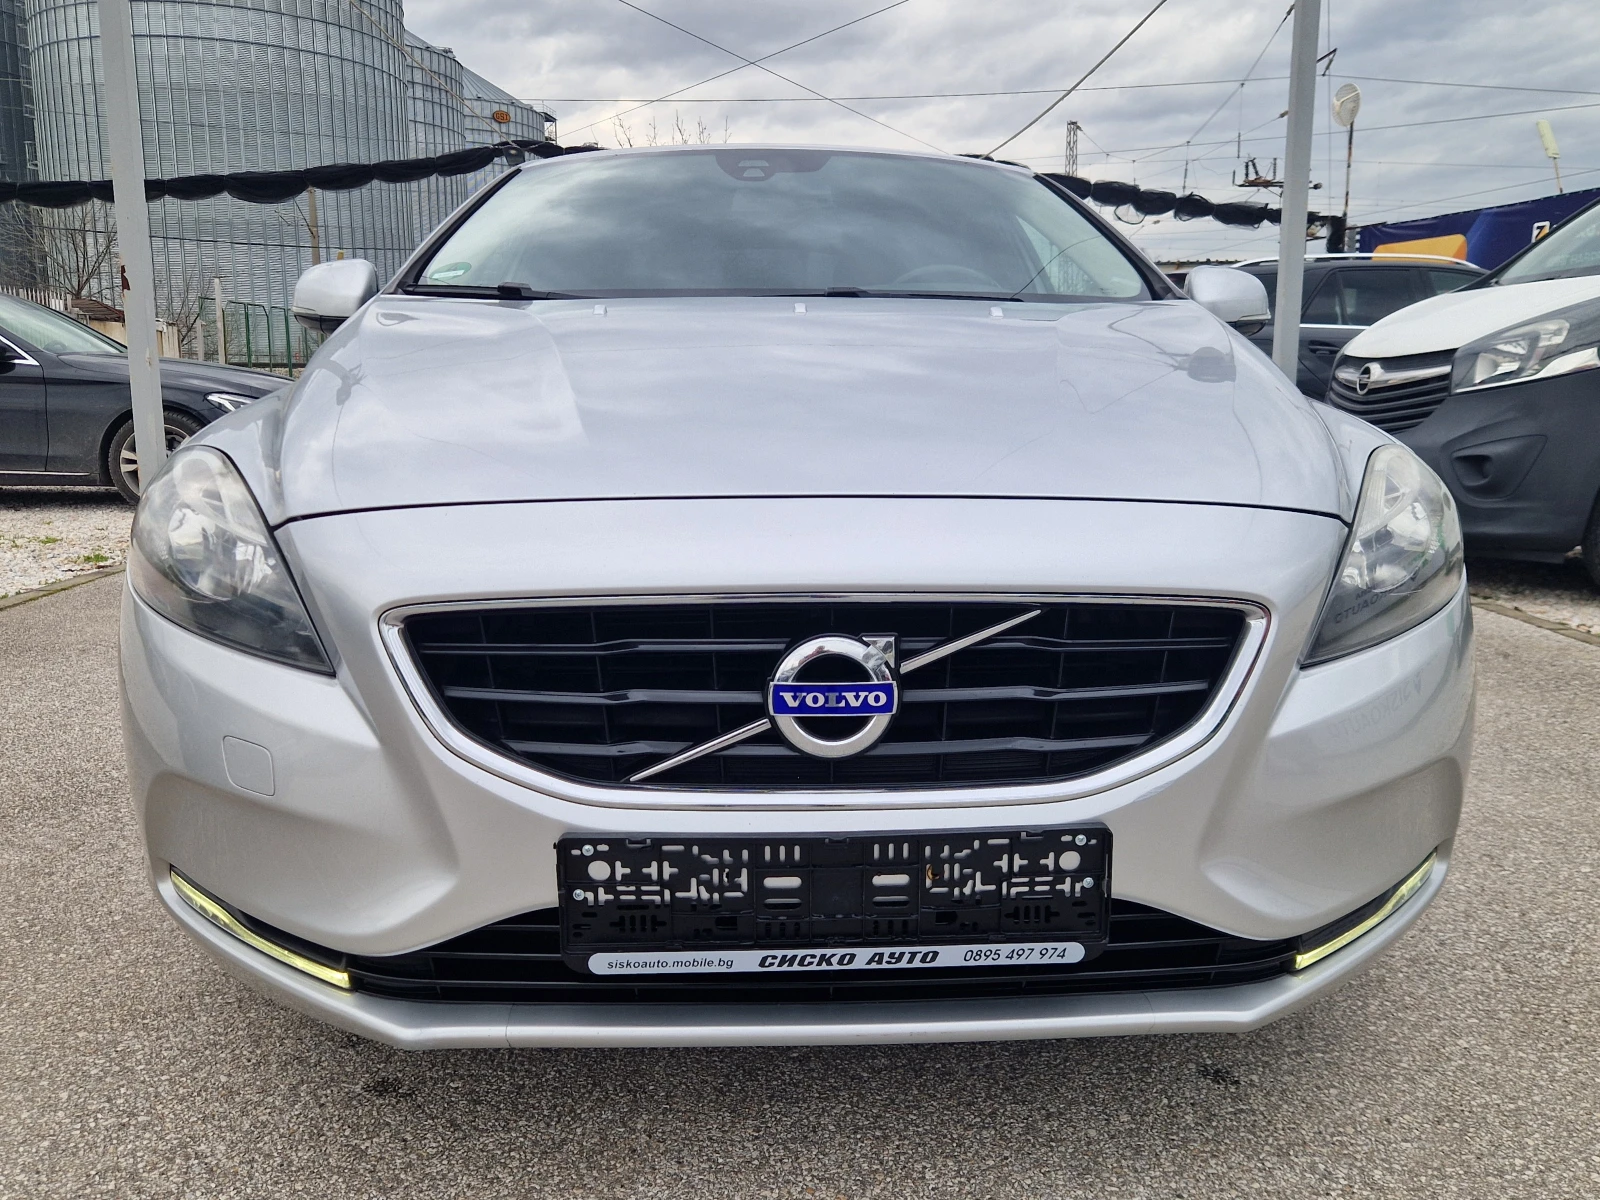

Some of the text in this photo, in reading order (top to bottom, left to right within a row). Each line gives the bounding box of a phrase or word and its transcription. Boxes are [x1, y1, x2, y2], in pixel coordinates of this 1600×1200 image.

[495, 112, 508, 121] GSI
[779, 691, 887, 708] VOLVO
[758, 950, 940, 968] СИСКО АУТО
[963, 947, 1068, 962] 0895 497 974
[606, 957, 734, 970] siskoauto.mobile.bg
